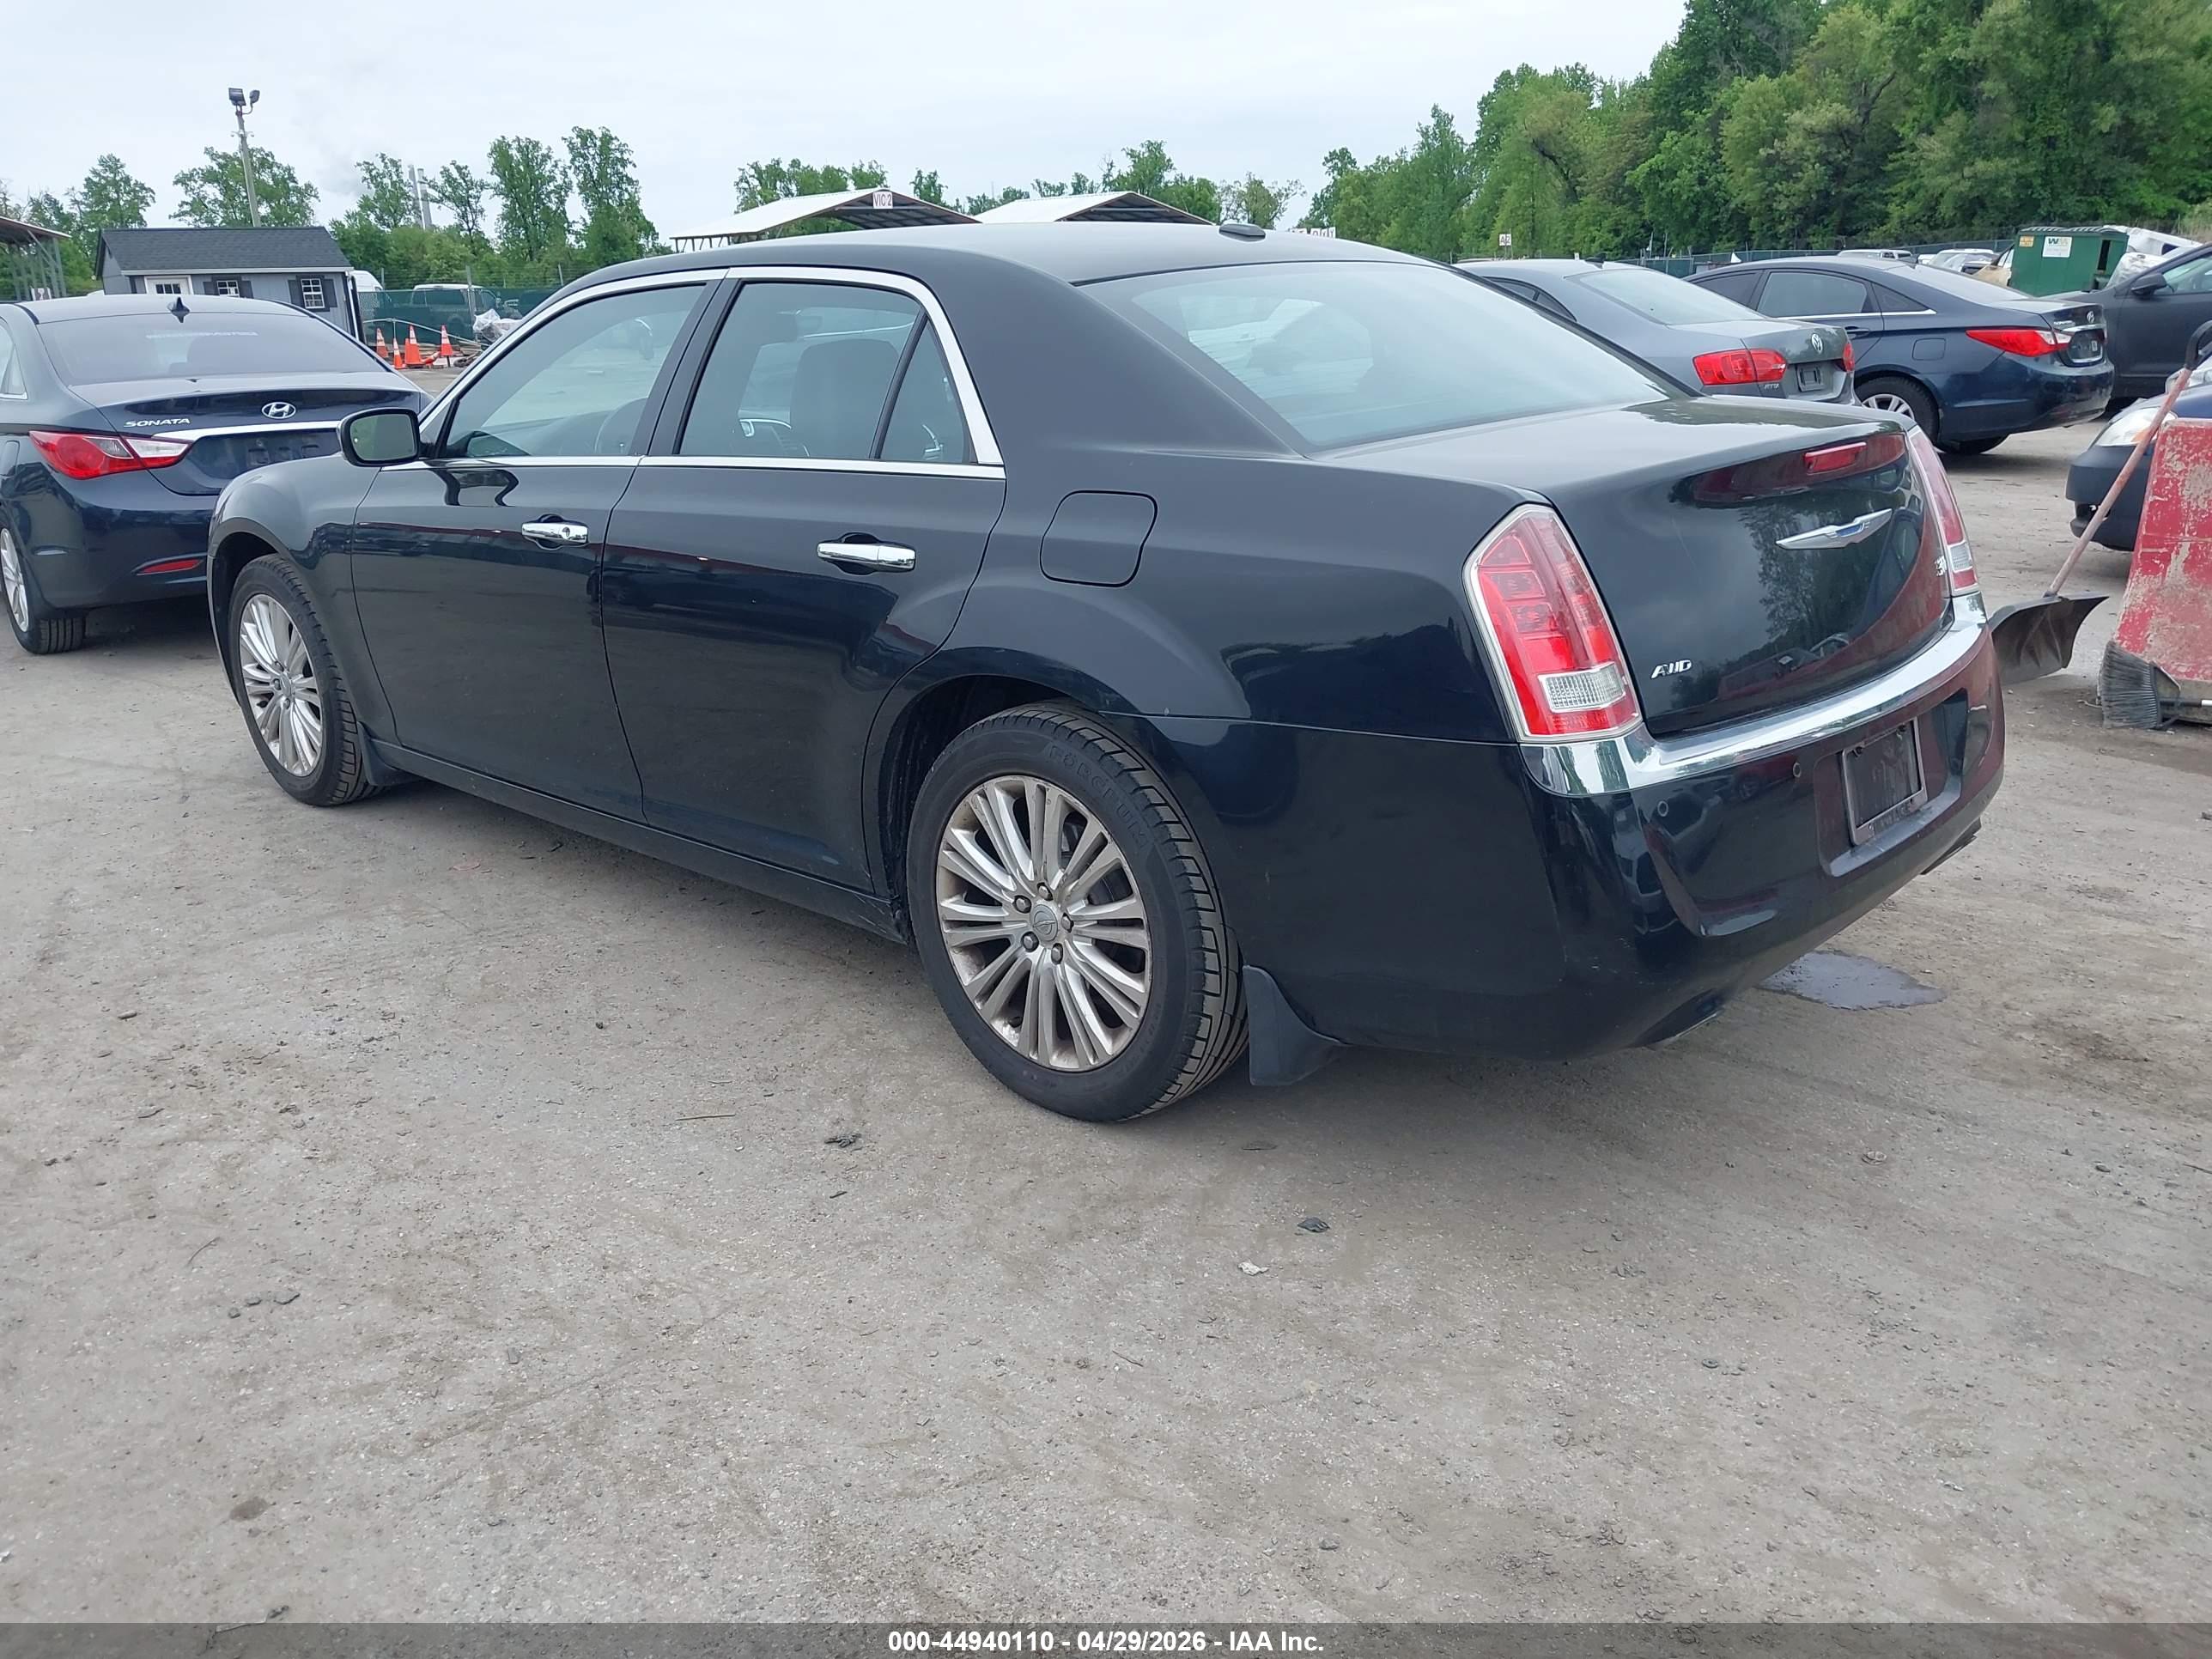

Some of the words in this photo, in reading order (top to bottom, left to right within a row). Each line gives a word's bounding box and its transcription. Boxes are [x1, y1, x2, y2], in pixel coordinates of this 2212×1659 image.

[873, 193, 886, 207] VIC
[887, 193, 892, 207] 2
[124, 417, 191, 428] SONATA
[1650, 659, 1692, 679] AWD
